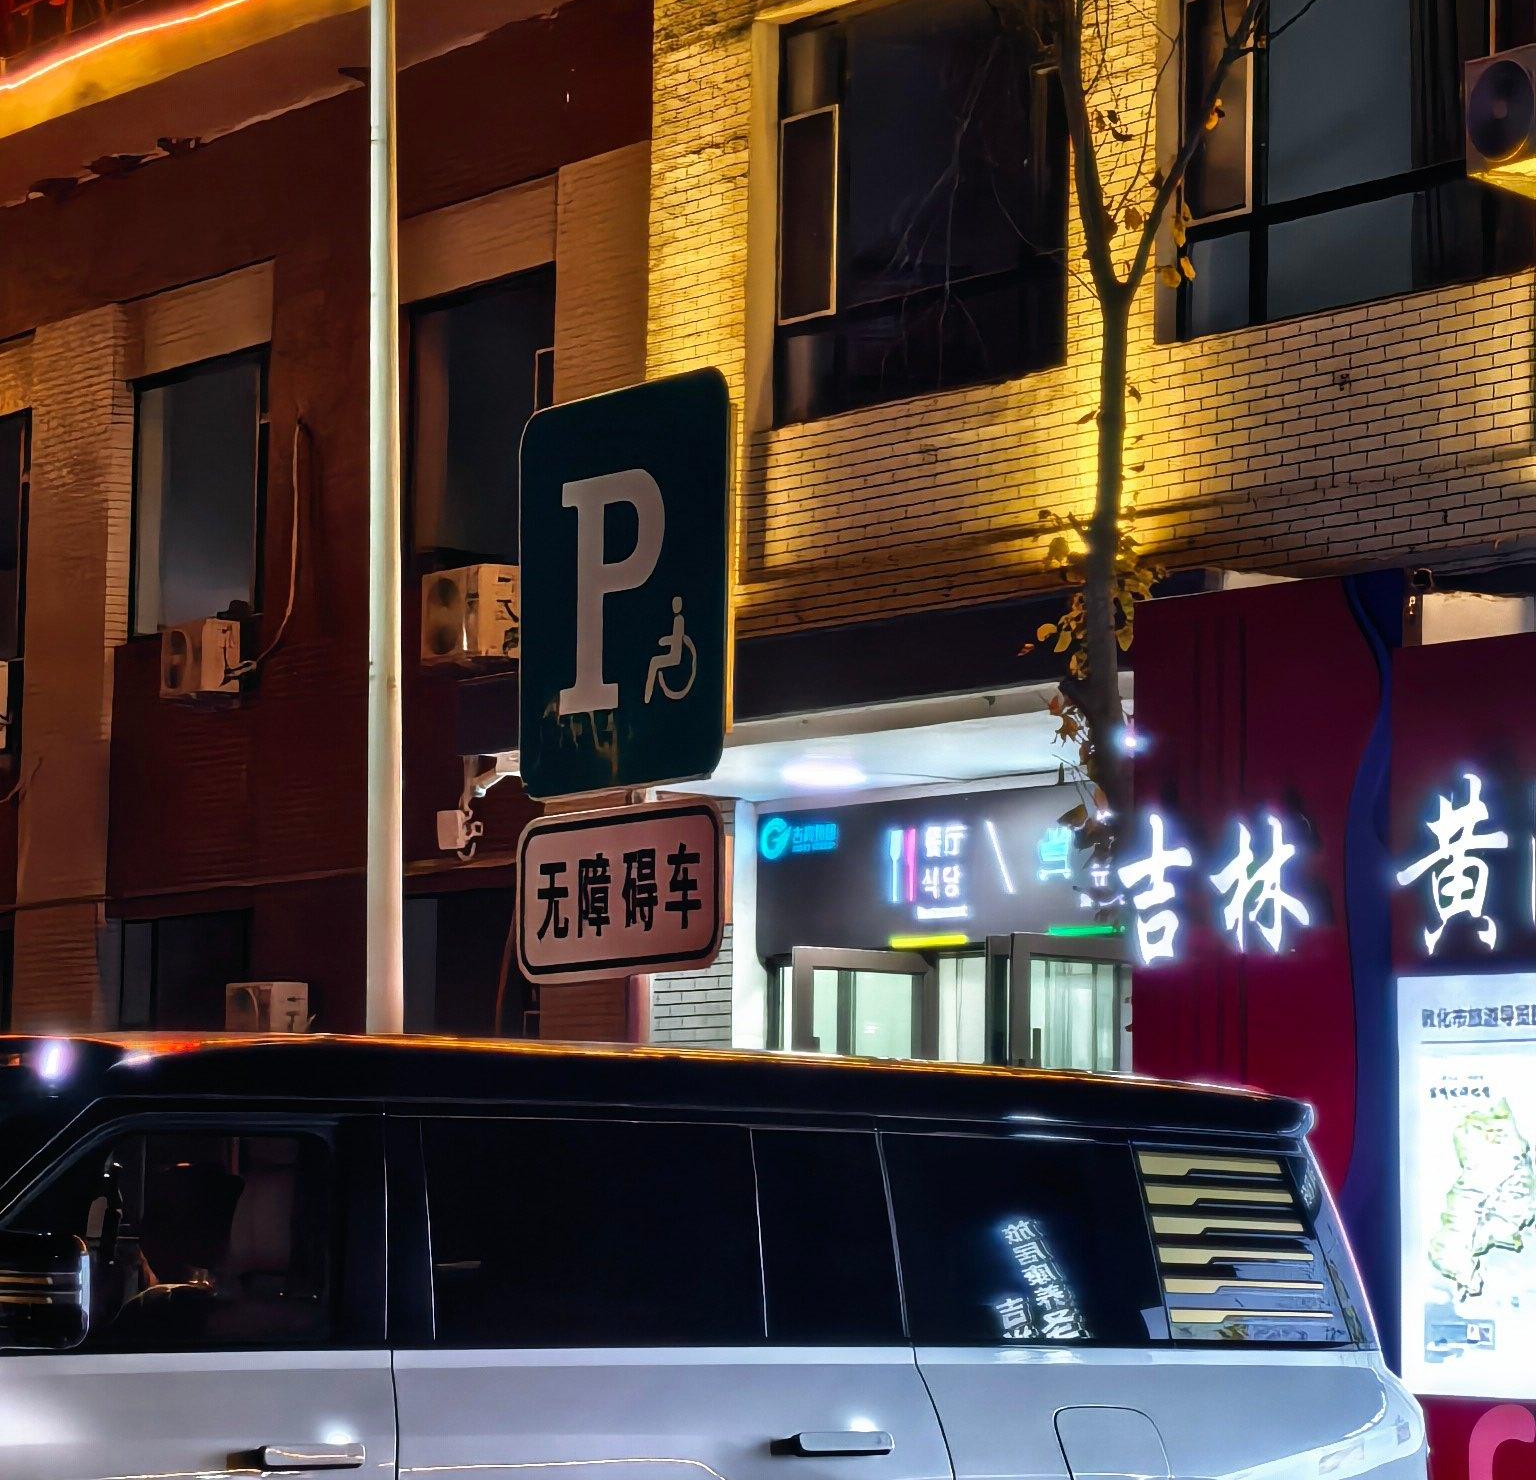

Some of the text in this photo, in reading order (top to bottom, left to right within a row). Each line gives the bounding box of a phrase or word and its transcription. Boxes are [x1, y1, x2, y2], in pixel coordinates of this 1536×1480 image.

[559, 468, 666, 716] P
[536, 842, 702, 941] 无障碍车
[1117, 773, 1536, 965] 吉林 黄
